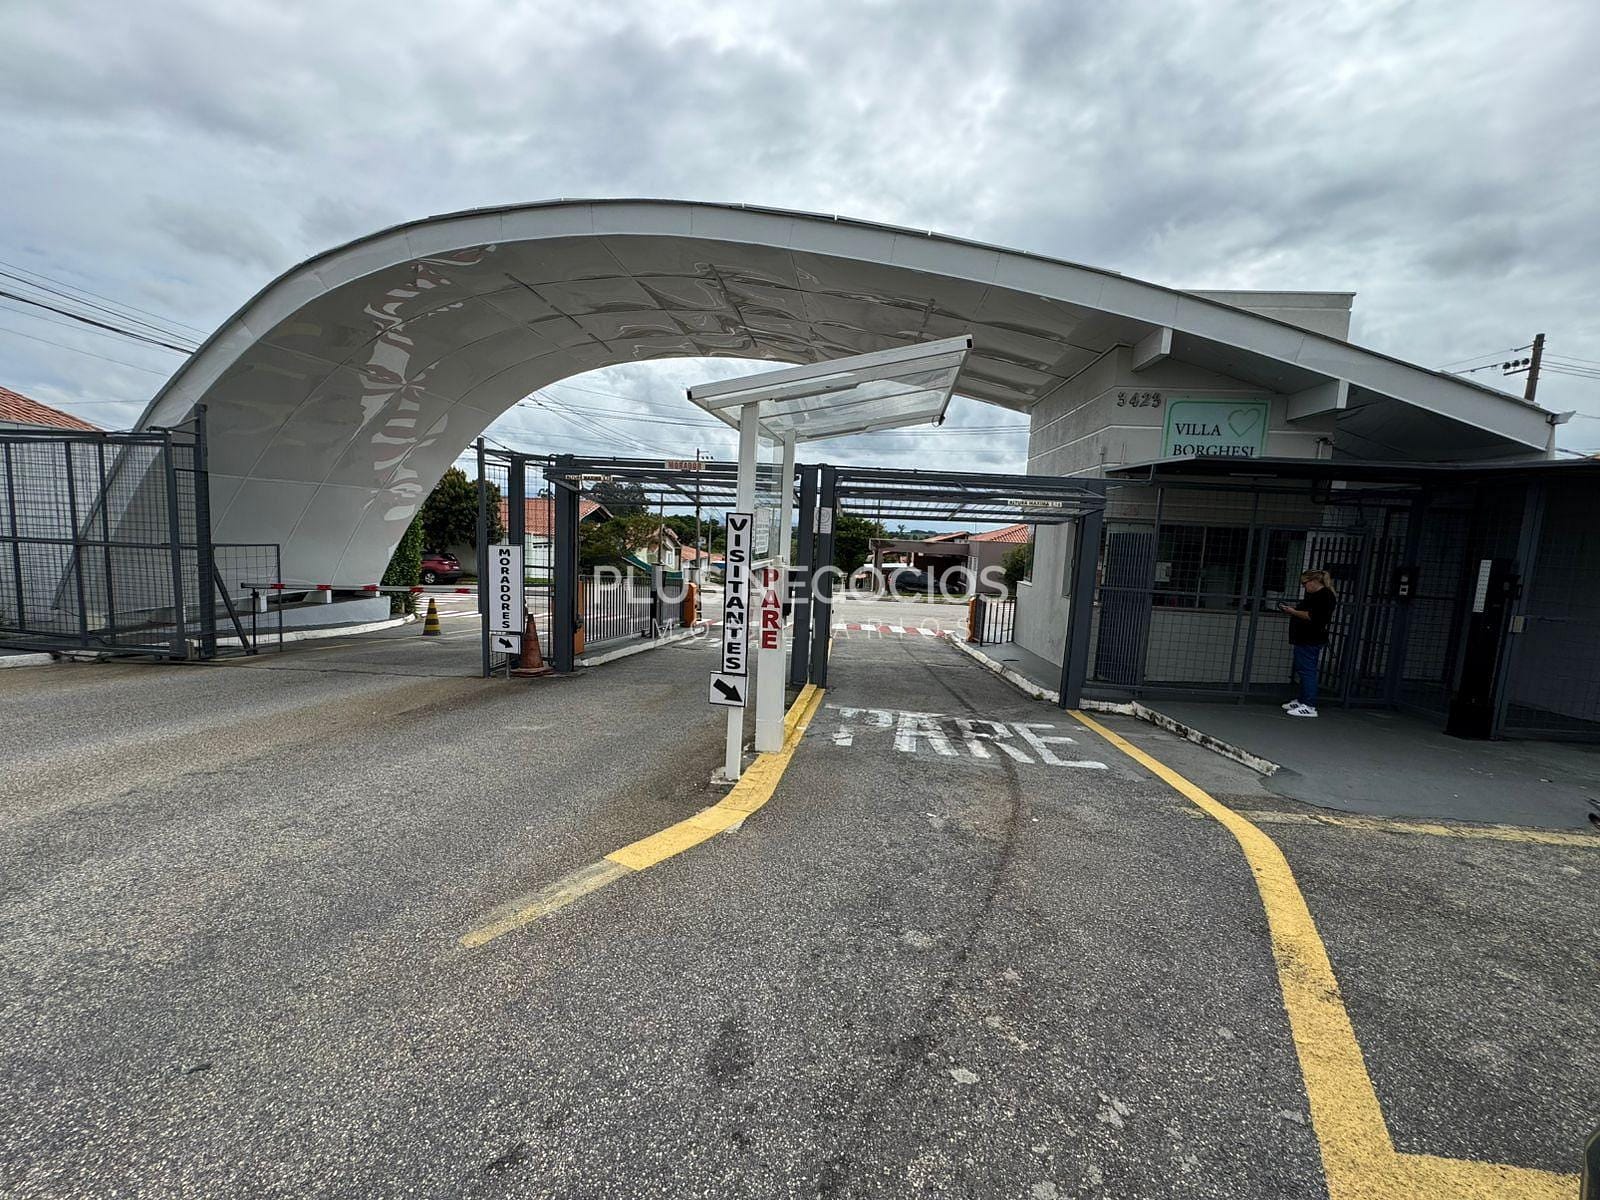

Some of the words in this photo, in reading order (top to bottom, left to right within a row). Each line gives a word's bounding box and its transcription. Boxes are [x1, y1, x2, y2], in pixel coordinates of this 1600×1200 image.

[1172, 443, 1256, 457] BORGHESI
[1174, 422, 1222, 437] VILLA
[498, 548, 512, 629] MORADORES
[726, 517, 748, 670] VISITANTES
[760, 567, 781, 650] PARE
[829, 706, 1109, 770] PARE
